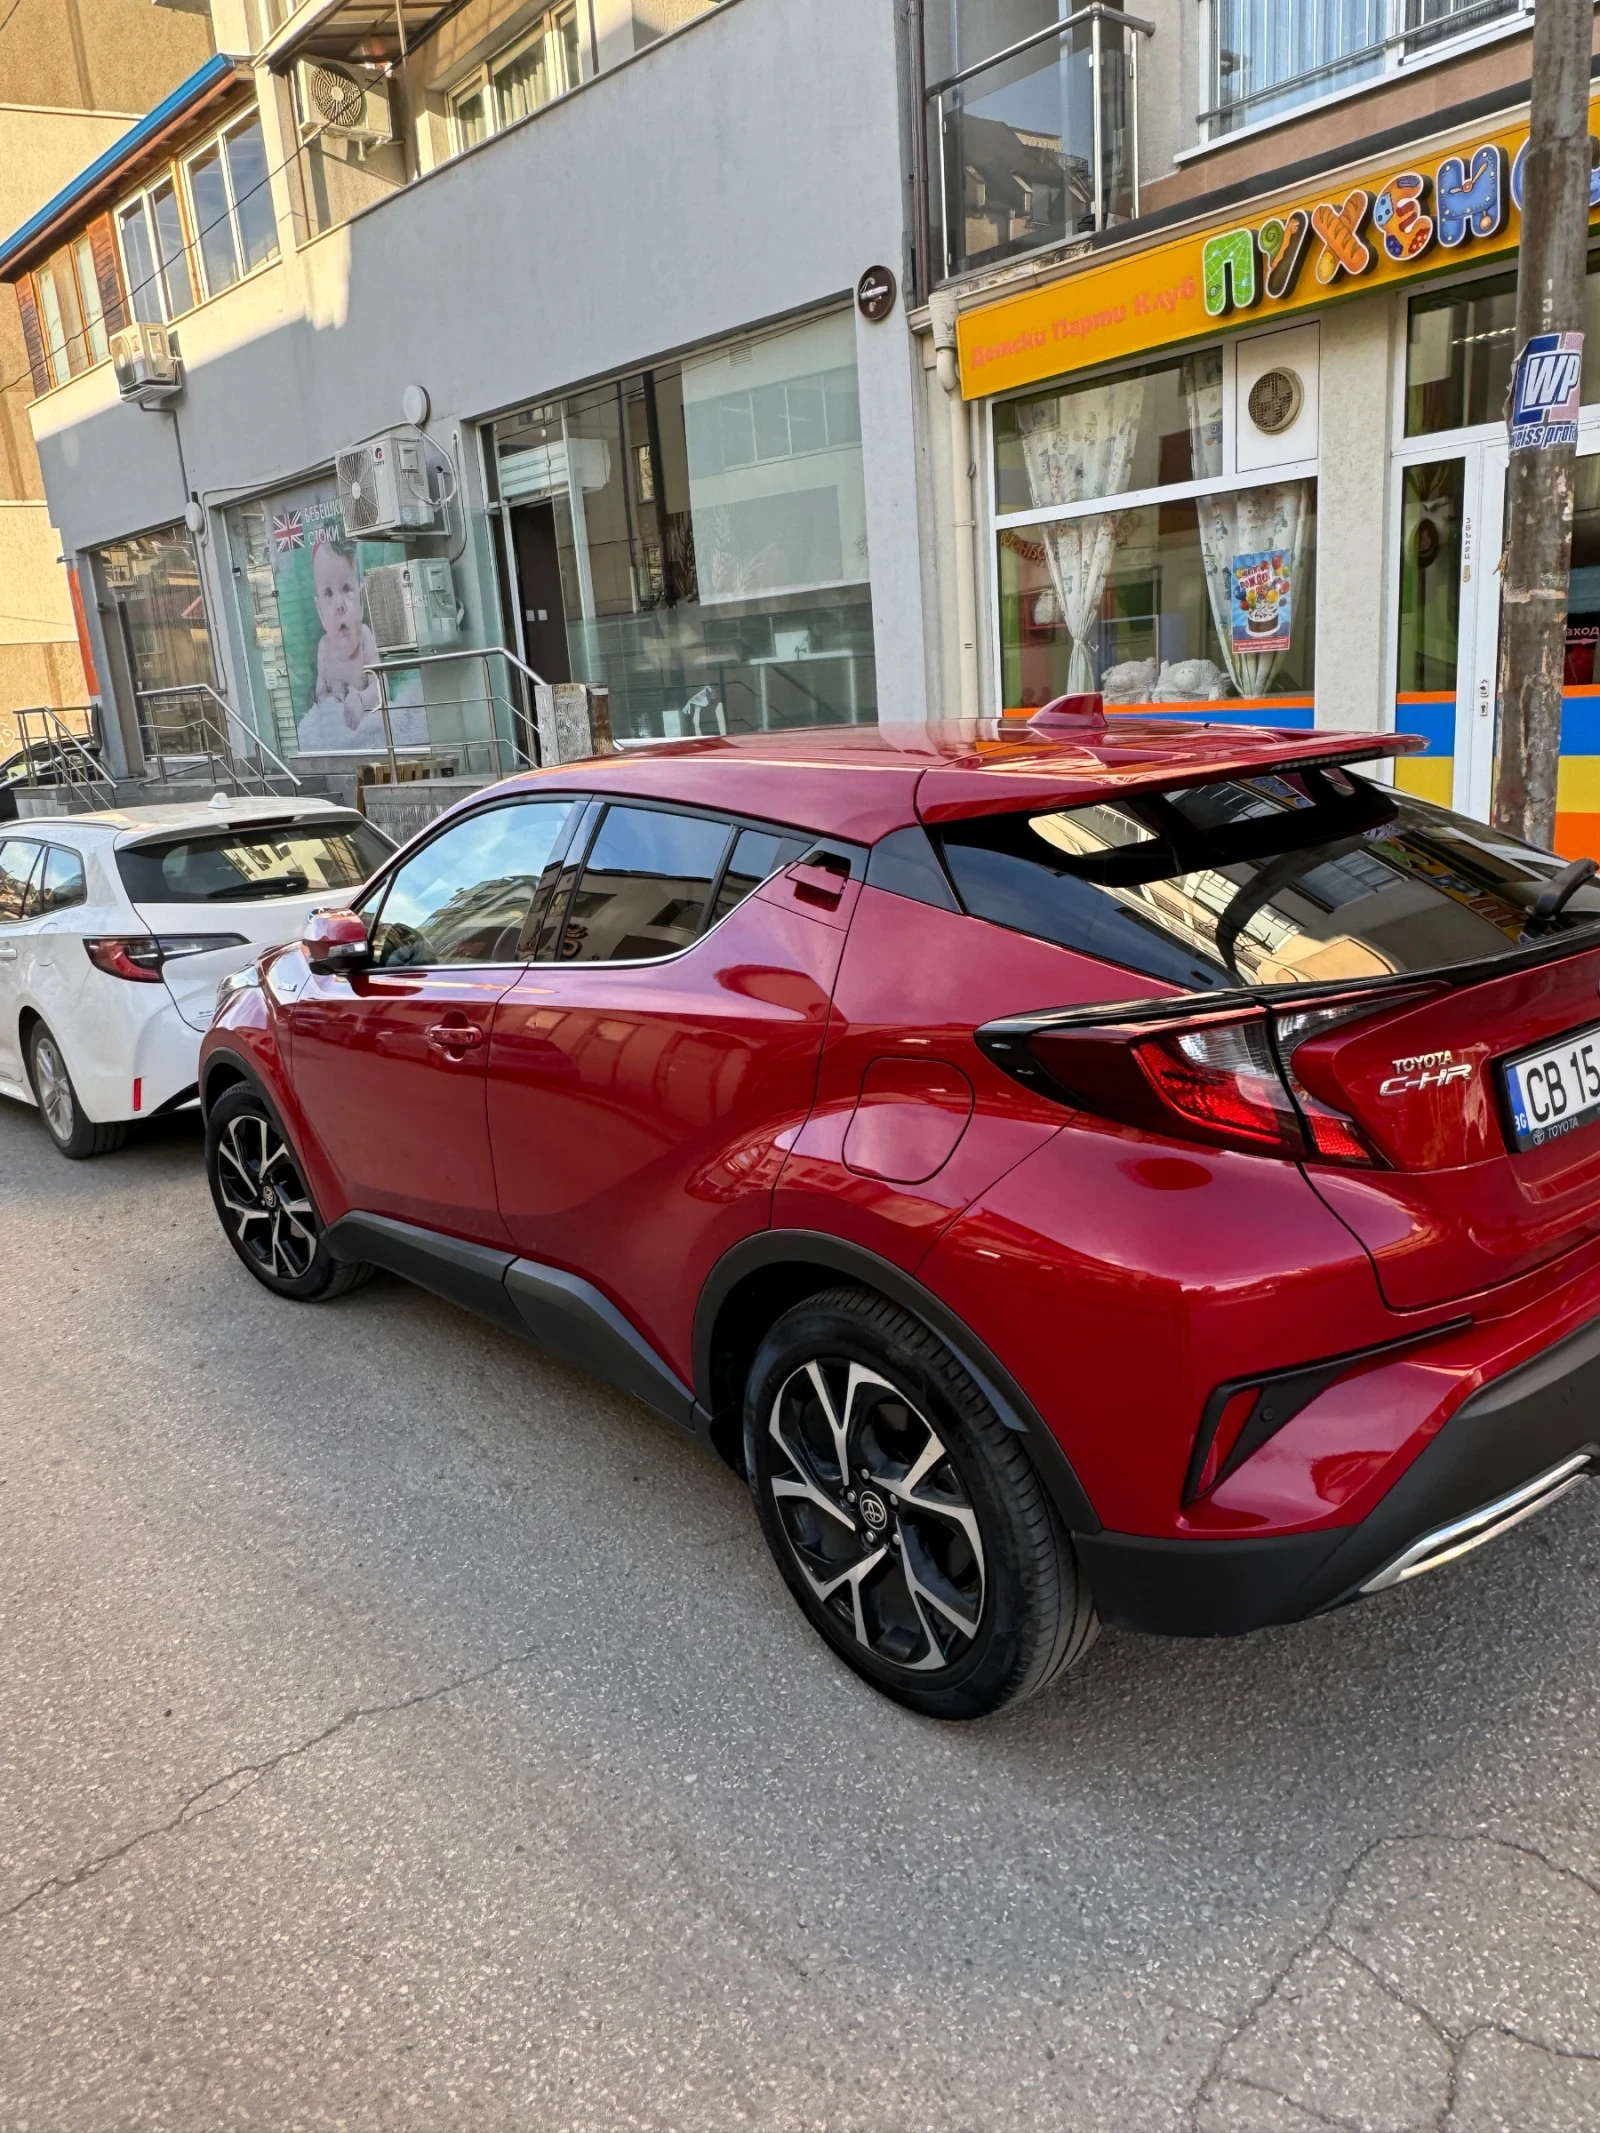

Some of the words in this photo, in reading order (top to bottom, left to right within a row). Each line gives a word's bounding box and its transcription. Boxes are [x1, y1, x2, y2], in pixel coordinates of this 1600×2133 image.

[1133, 274, 1196, 317] Клуб
[1524, 353, 1581, 409] WP
[308, 525, 340, 546] СТОКИ
[1392, 1050, 1453, 1074] TOYOTA
[1380, 1064, 1472, 1096] C-HR
[1526, 1060, 1567, 1123] CB
[1547, 1116, 1578, 1139] TOYOTA
